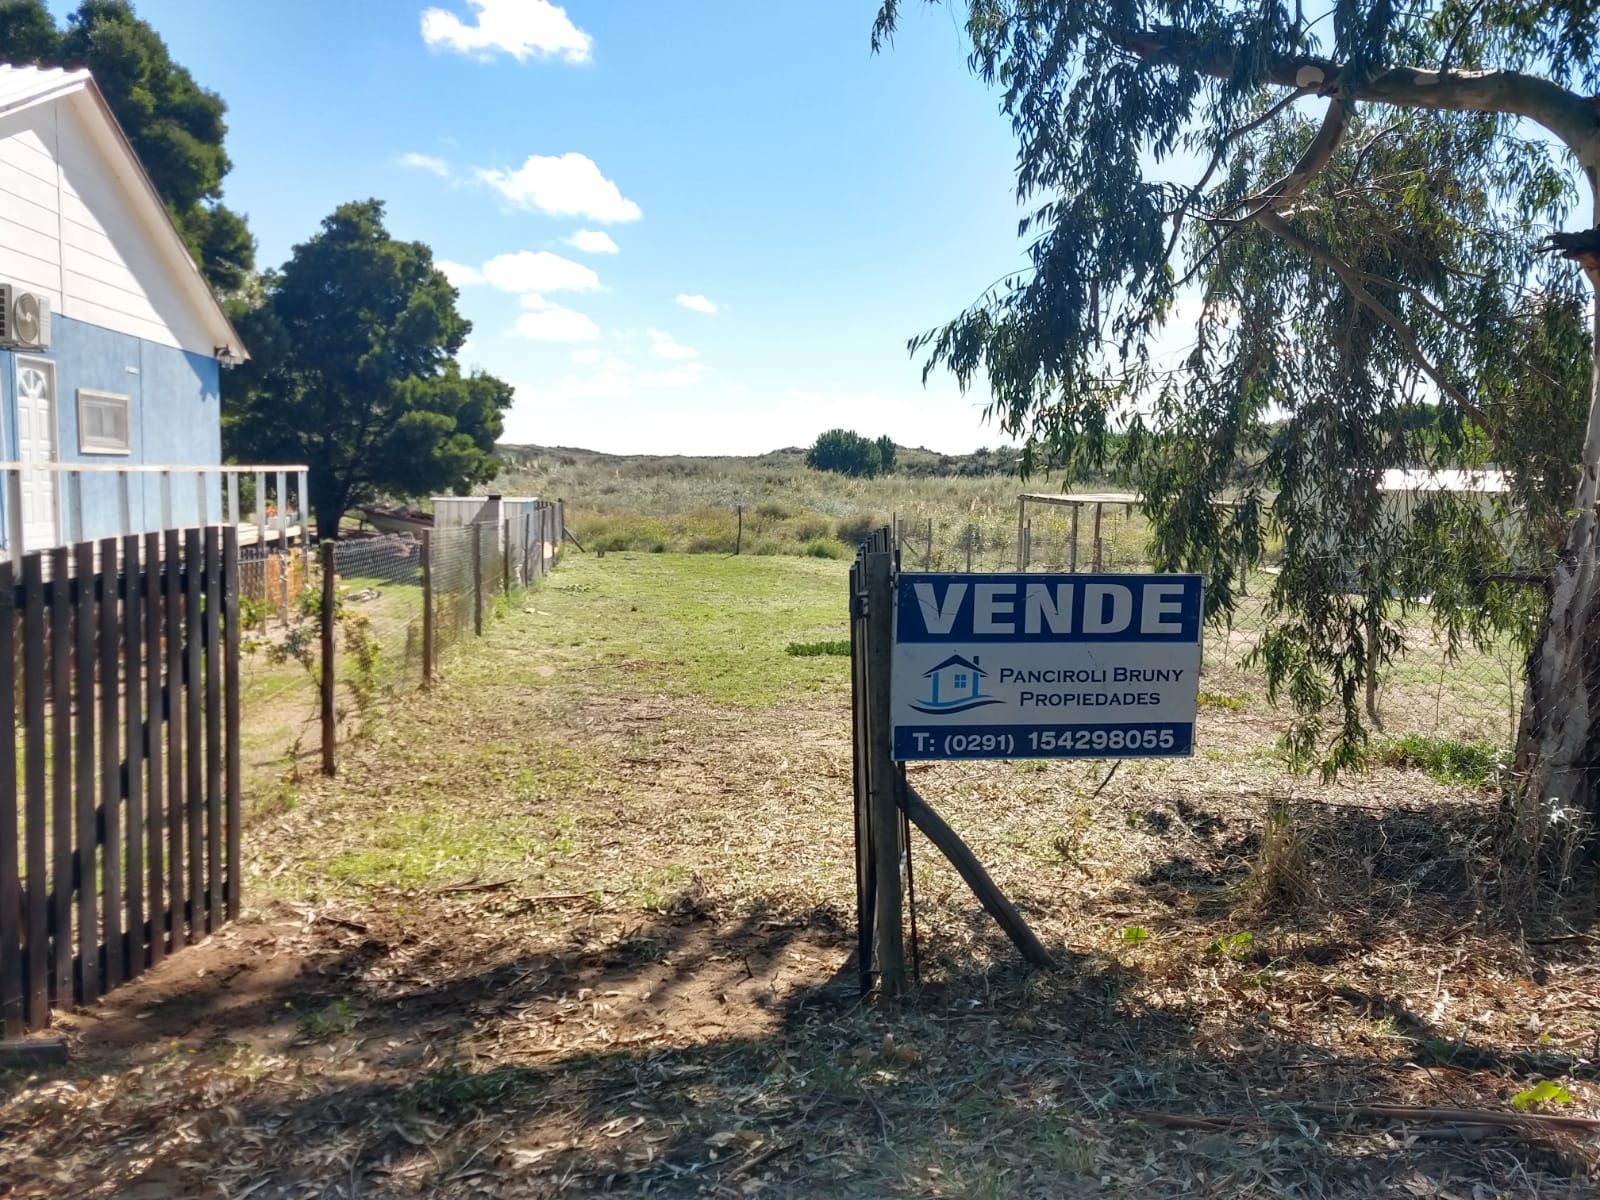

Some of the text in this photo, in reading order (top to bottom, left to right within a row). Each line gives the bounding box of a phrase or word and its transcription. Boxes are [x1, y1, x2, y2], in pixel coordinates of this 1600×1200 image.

[912, 583, 1185, 635] VENDE
[999, 666, 1184, 684] PANCIROLI BRUNY
[1019, 691, 1161, 707] PROPIEDADES
[912, 729, 1175, 755] T: (0291) 154298055
